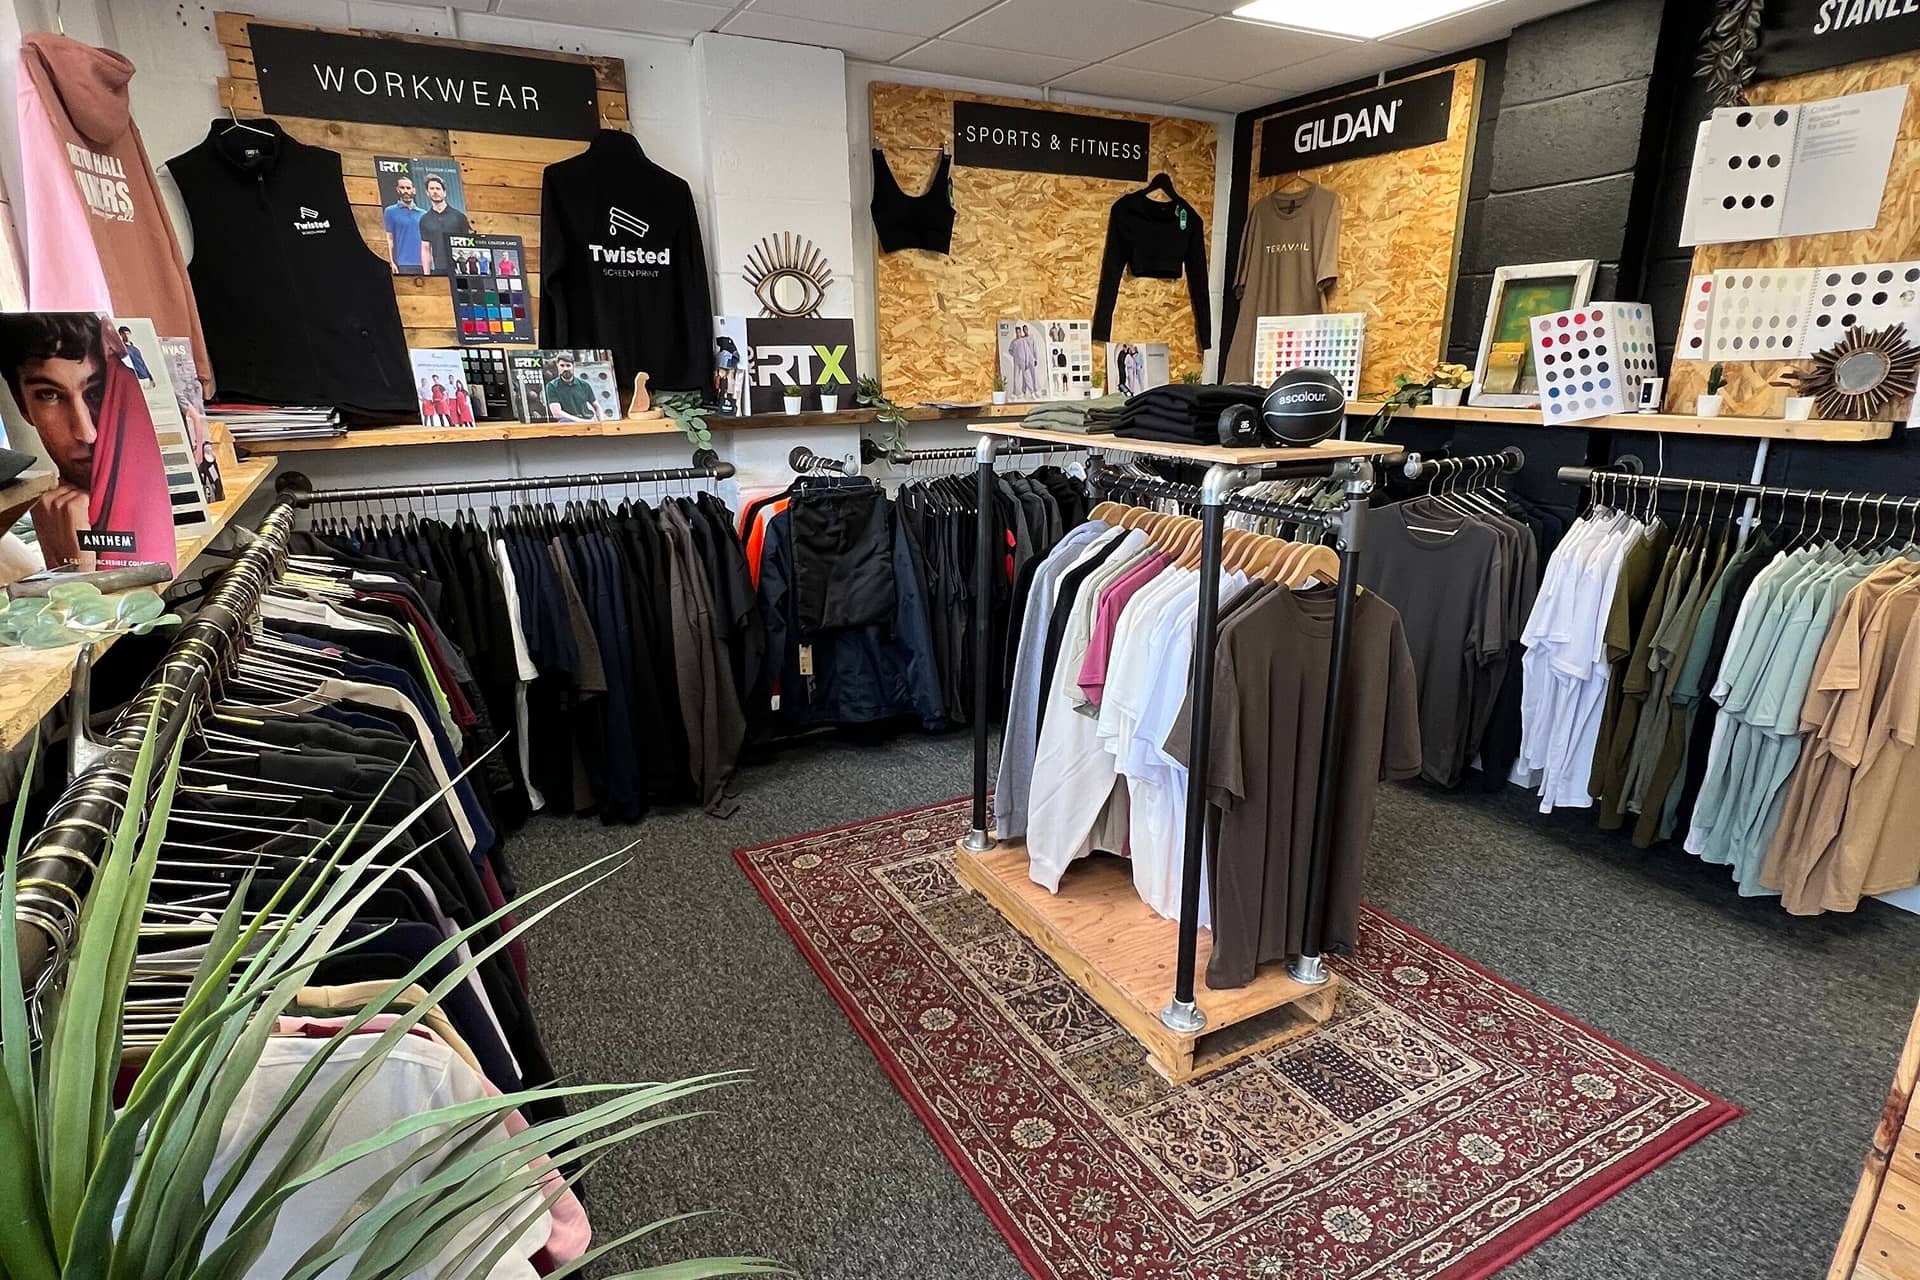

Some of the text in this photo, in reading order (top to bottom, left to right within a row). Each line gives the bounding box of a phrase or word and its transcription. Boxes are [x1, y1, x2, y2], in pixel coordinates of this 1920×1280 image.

[312, 63, 539, 111] WORKWEAR
[966, 125, 1142, 160] SPORTS & FITNESS
[1294, 100, 1397, 153] GILDAN
[293, 220, 331, 230] Twisted
[588, 244, 670, 265] Twisted
[756, 345, 851, 386] RTX
[83, 535, 132, 547] ANTHEM
